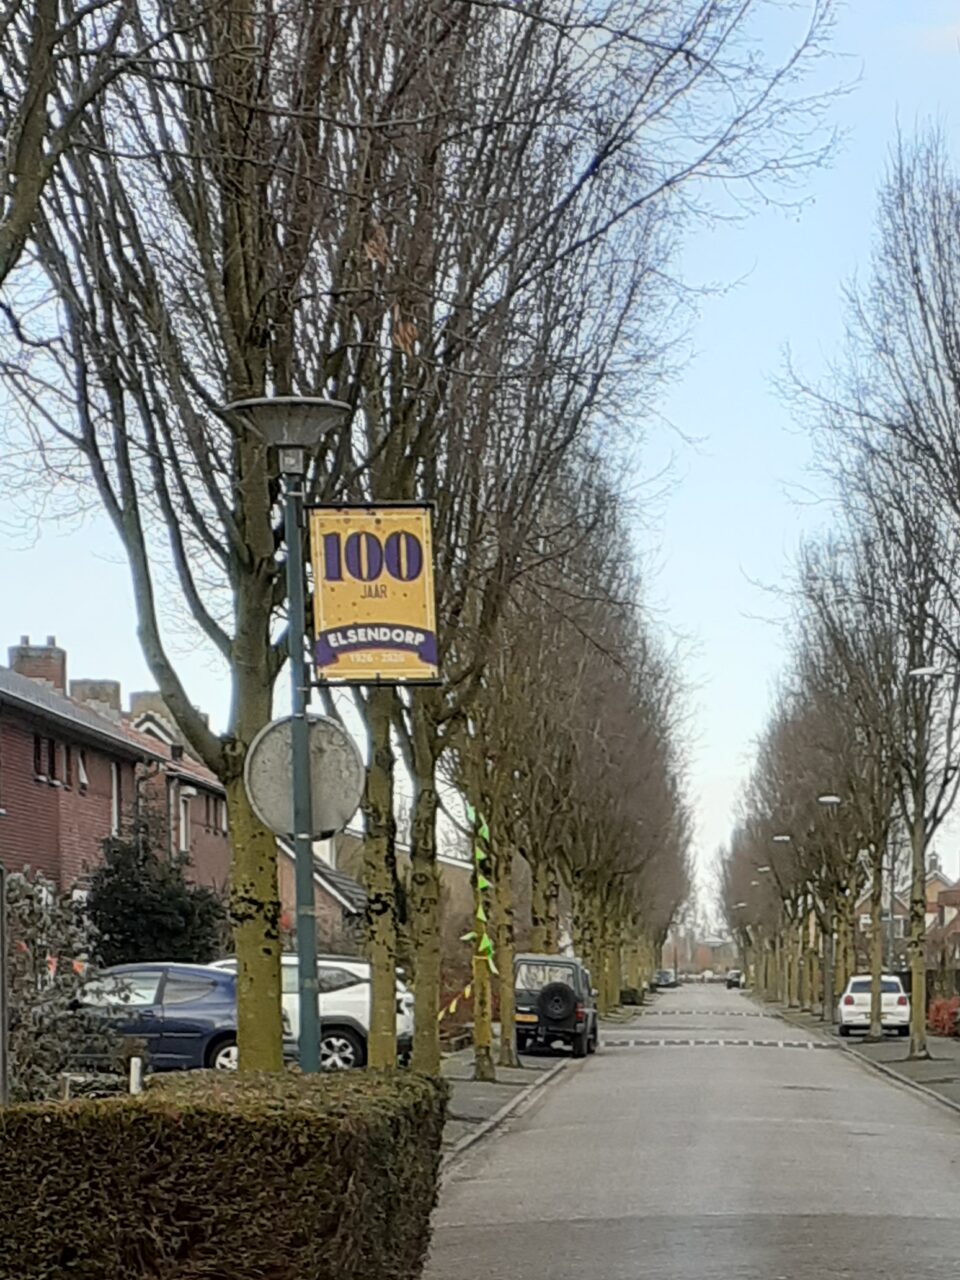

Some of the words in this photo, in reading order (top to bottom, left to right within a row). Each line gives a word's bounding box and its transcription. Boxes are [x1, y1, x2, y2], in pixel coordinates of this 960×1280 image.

[322, 530, 423, 582] 100
[360, 584, 388, 599] JAAR
[327, 627, 425, 648] ELSENDORP
